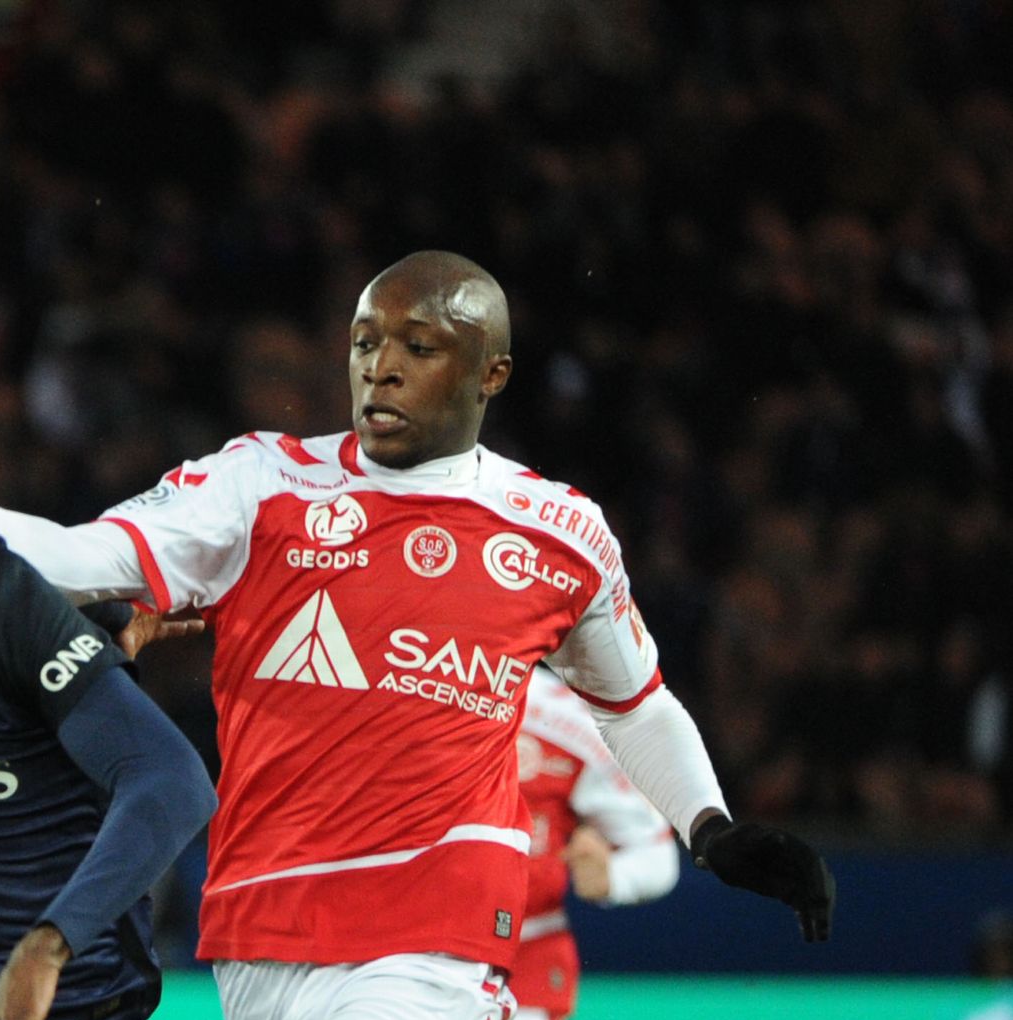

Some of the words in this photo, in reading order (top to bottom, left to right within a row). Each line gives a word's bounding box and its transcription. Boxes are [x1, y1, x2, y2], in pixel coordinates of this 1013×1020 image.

[286, 547, 370, 570] GEODIS
[39, 633, 104, 692] QNB
[376, 671, 517, 724] ASCENSEURS
